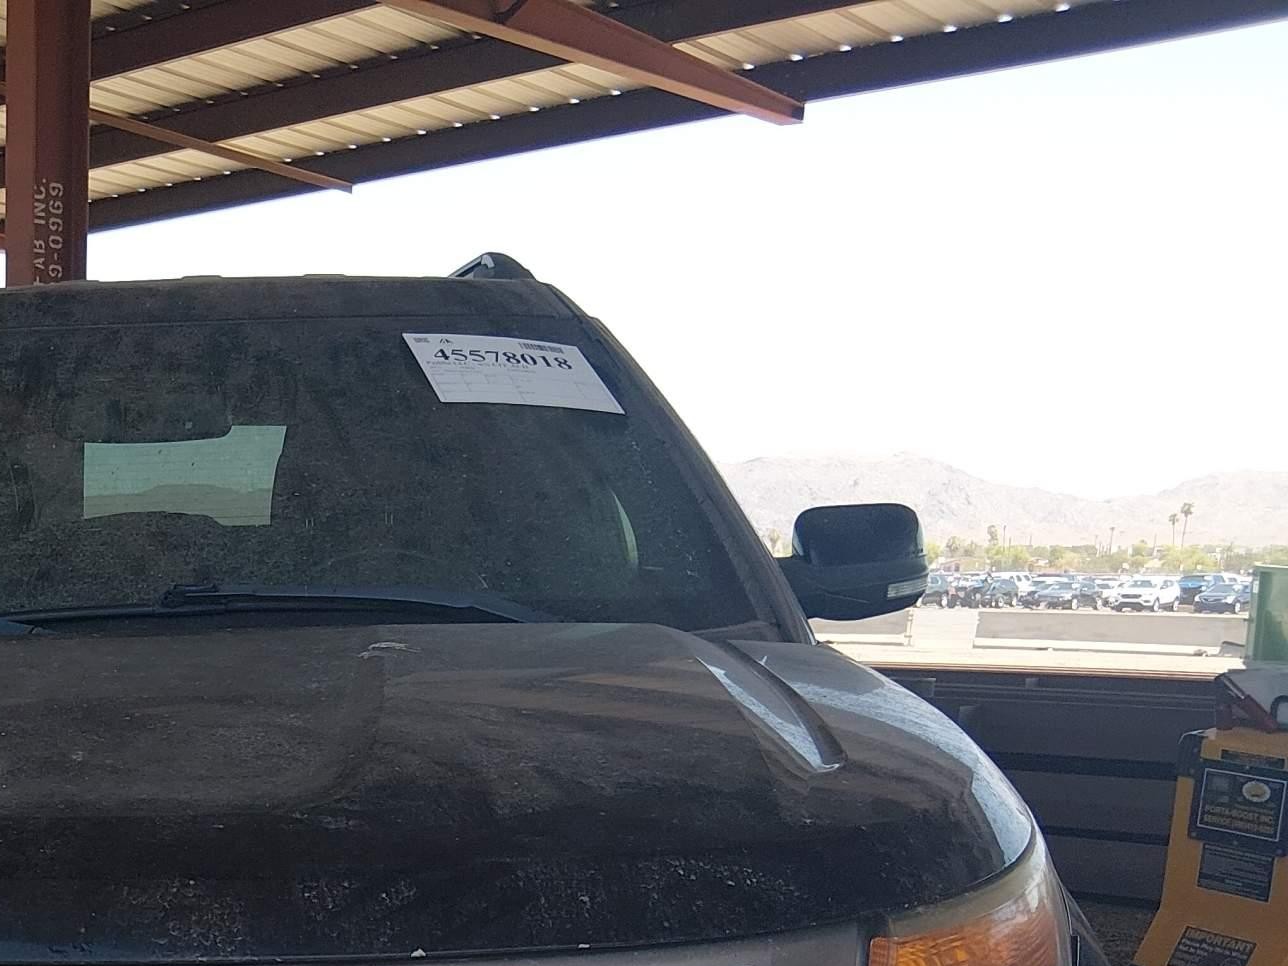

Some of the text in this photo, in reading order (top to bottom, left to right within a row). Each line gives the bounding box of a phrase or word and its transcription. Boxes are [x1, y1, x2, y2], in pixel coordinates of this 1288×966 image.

[33, 178, 47, 225] INC.
[49, 182, 64, 285] 9-0969
[434, 348, 573, 370] 45578018
[1185, 928, 1252, 952] IMPORTANT
